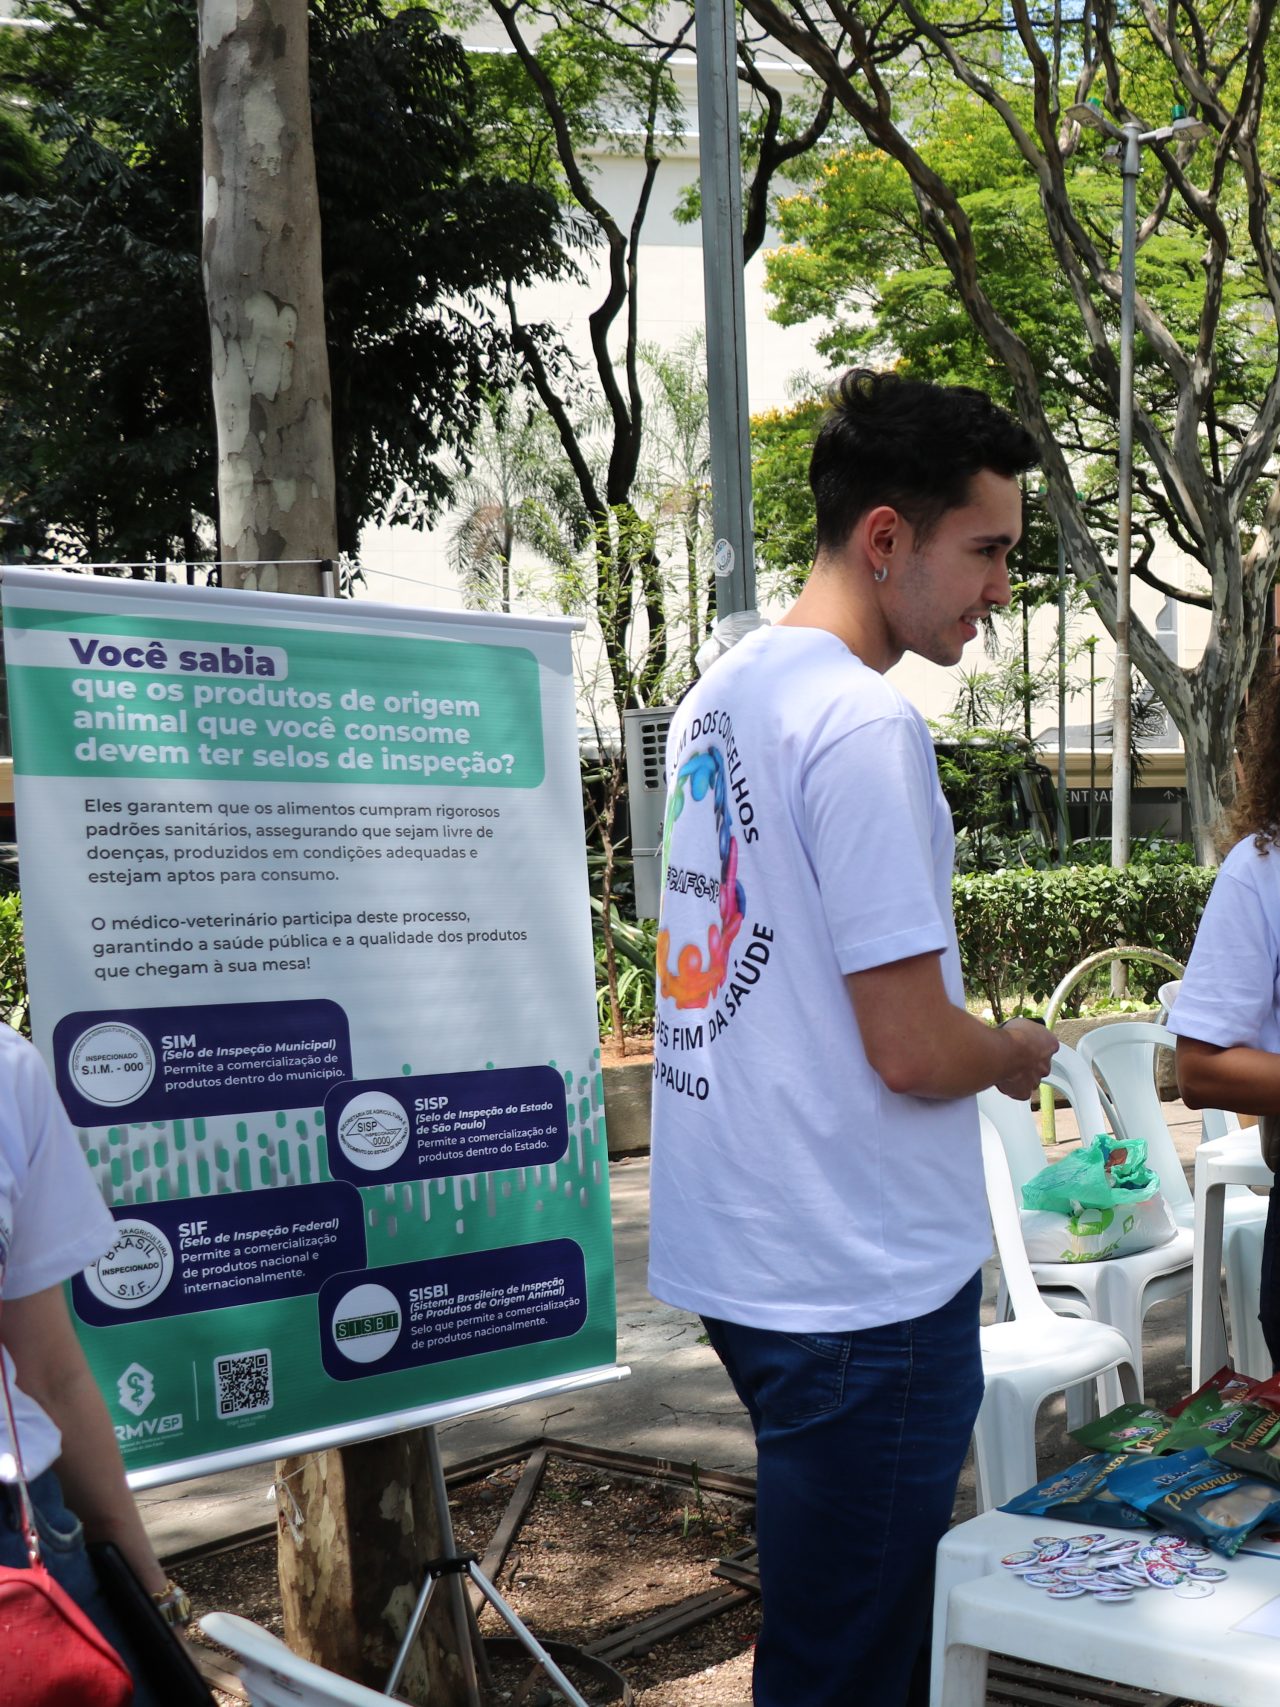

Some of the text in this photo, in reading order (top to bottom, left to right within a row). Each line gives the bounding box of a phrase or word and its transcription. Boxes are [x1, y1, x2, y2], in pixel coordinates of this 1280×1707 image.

[68, 638, 275, 676] Você sabia
[72, 678, 482, 720] que os produtos de origem
[74, 709, 471, 745] animal que você consome
[75, 737, 515, 779] devem ter selos de inspeção?
[691, 710, 759, 844] DOS CONSELHOS
[84, 798, 500, 820] Eles garantem que os alimentos cumpram rigorosos
[86, 821, 493, 840] padrões sanitários, assegurando que sejam livre de
[86, 844, 478, 863] doenças, produzidos em condições adequadas e
[88, 868, 339, 886] estejam aptos para consumo.
[91, 910, 470, 931] O médico-veterinário participa deste processo,
[92, 929, 527, 958] garantindo a saúde pública e a qualidade dos produtos
[94, 956, 310, 981] que chegam à sua mesa!
[673, 923, 774, 1051] FIM DA SAÚDE
[161, 1034, 196, 1049] SIM
[162, 1038, 336, 1062] (Selo de Inspeção Municipal)
[81, 1061, 144, 1075] S.I.M. 000
[85, 1052, 138, 1062] INSPECIONADO
[164, 1053, 338, 1075] Permite a comercialização de
[165, 1067, 345, 1092] produtos dentro do município.
[661, 1063, 709, 1101] PAULO
[414, 1096, 448, 1111] SISP
[415, 1101, 553, 1125] (Selo de Inspeção do Estado
[340, 1109, 403, 1132] SECRETARIA AGRICULTURA
[358, 1122, 377, 1132] SISP
[416, 1118, 486, 1135] de São Paulo)
[373, 1136, 390, 1145] 0000
[418, 1139, 549, 1164] produtos dentro do Estado.
[178, 1220, 208, 1237] SIF
[179, 1218, 339, 1251] (Selo de Inspeção Federal)
[105, 1238, 155, 1260] BRASIL
[130, 1228, 168, 1258] AGRICULTURA
[181, 1235, 337, 1264] Permite a comercialização
[102, 1262, 160, 1277] INSPECIONADO
[118, 1281, 150, 1296] S.I.F.
[184, 1269, 305, 1294] internacionalmente.
[409, 1283, 448, 1302] SISBI
[338, 1316, 396, 1337] SISBI
[410, 1296, 580, 1336] Selo que permite a comercialização
[114, 1418, 179, 1440] RMV SP
